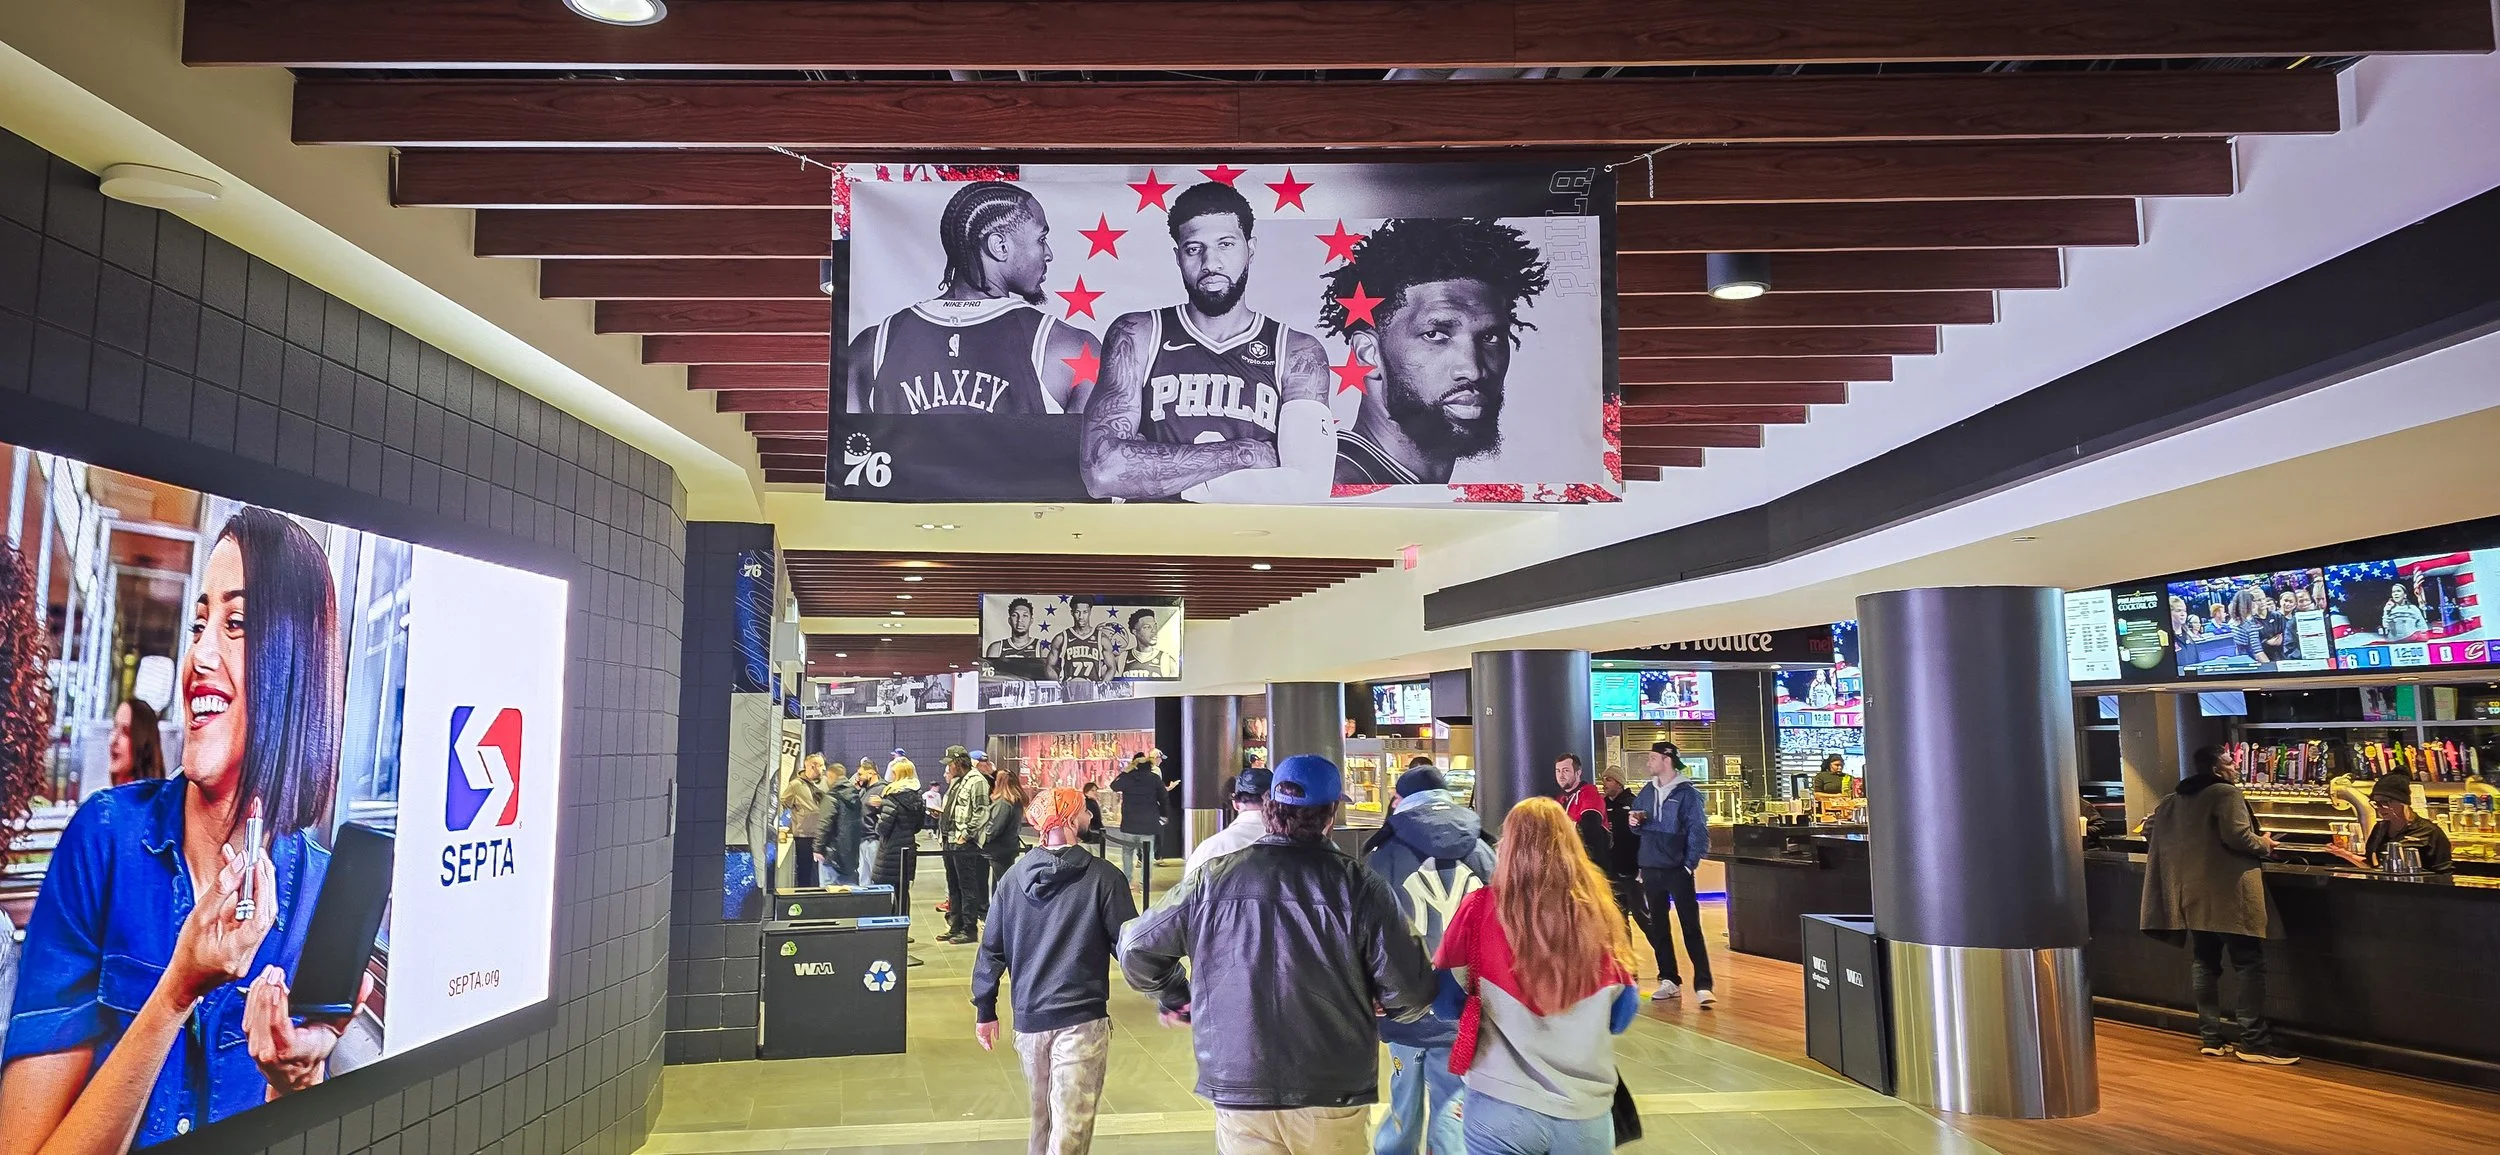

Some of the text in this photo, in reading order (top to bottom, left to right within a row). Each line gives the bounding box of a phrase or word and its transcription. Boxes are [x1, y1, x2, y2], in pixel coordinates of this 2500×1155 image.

[900, 370, 1009, 415] MAXEY
[1150, 373, 1278, 433] PHILA
[844, 450, 892, 487] 76
[1066, 645, 1099, 661] PHILA
[1072, 662, 1094, 676] 77
[440, 837, 515, 887] SEPTA
[448, 969, 500, 997] SEPTA.org
[794, 962, 835, 976] WM
